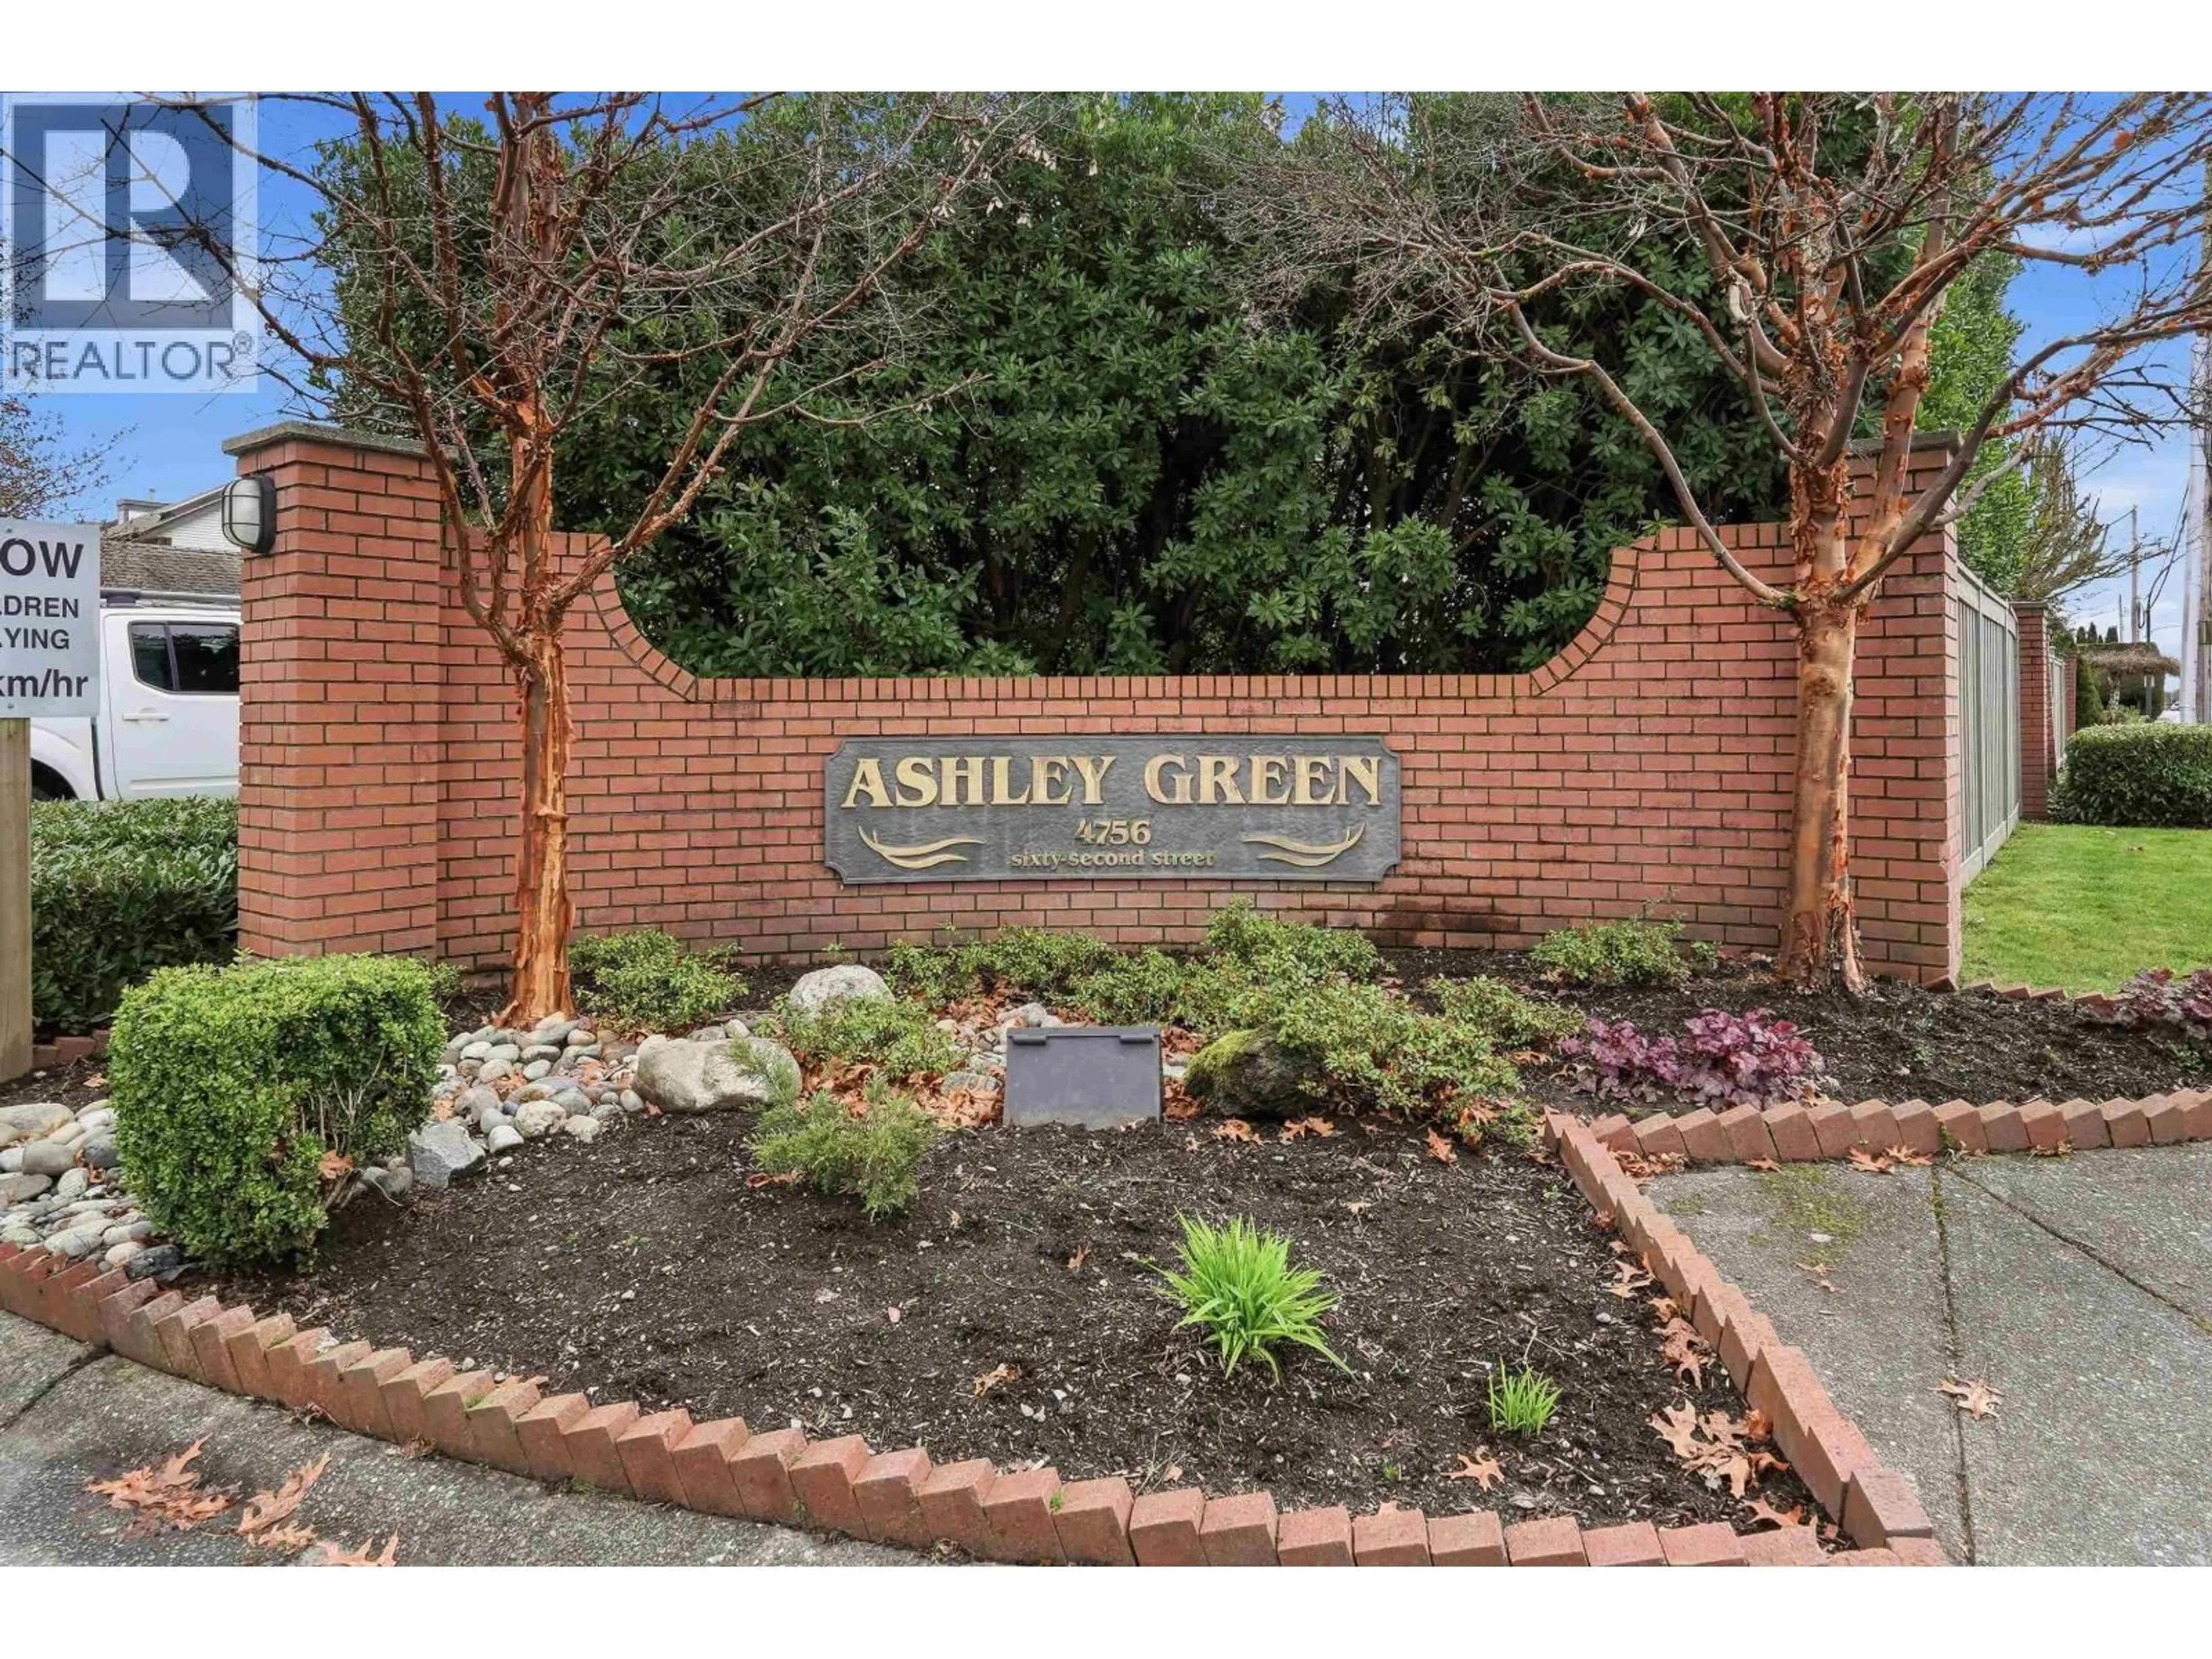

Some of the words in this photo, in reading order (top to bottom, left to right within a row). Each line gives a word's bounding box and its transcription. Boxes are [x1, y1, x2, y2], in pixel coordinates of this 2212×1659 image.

[0, 595, 78, 618] DREN
[0, 628, 69, 649] YING
[841, 756, 1116, 808] ASHLEY
[1144, 754, 1381, 805] GREEN
[1074, 818, 1152, 845] 4756
[1152, 851, 1215, 868] street
